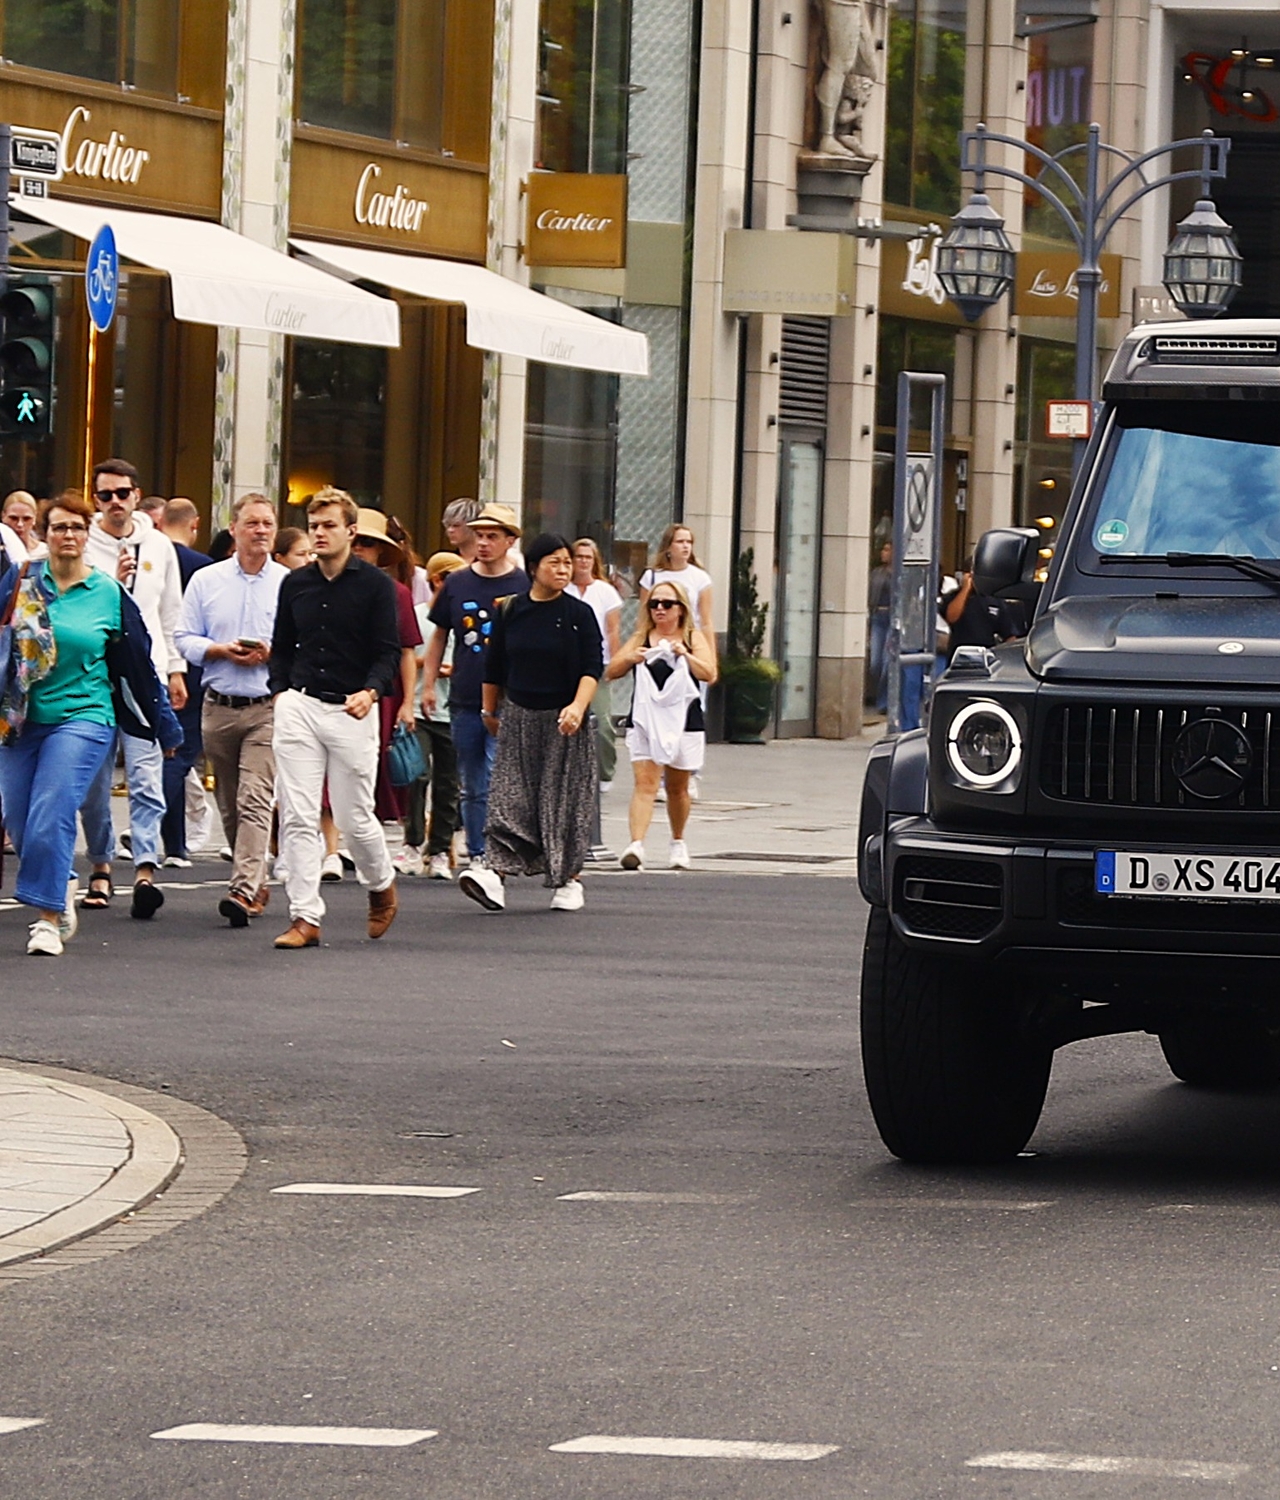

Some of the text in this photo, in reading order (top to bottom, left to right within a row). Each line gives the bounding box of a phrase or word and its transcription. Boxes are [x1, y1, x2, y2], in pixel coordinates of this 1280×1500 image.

[61, 105, 149, 184] Cartier
[354, 163, 428, 231] Cartier
[536, 209, 612, 231] Cartier
[264, 292, 307, 329] Cartier
[540, 324, 576, 359] Cartier
[1102, 876, 1110, 885] D
[1129, 857, 1149, 889] D
[1173, 858, 1215, 892] XS
